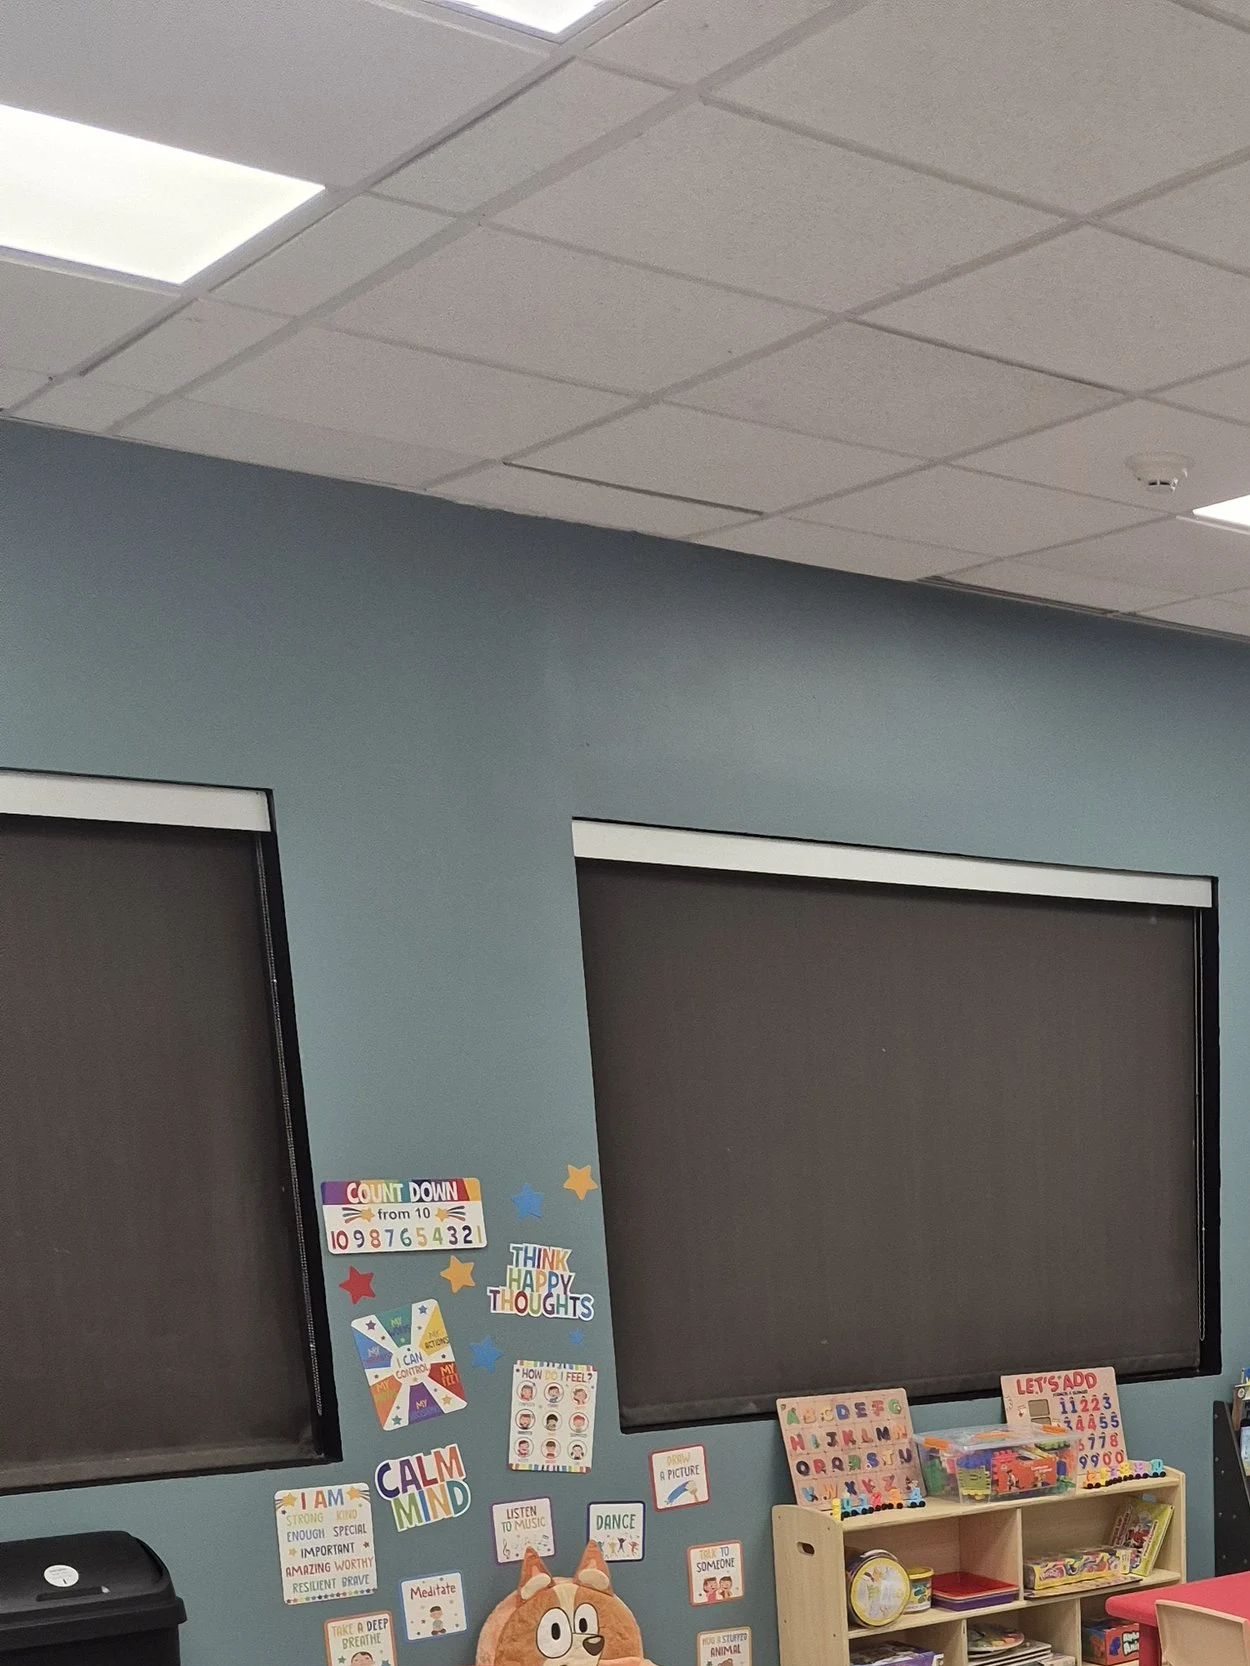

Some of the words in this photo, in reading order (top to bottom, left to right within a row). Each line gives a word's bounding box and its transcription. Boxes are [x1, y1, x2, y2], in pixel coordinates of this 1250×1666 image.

[346, 1181, 404, 1204] COUNT
[408, 1181, 458, 1203] DOWN
[377, 1208, 410, 1220] from
[415, 1207, 430, 1219] 10
[330, 1230, 349, 1250] 10
[353, 1229, 365, 1248] 9
[369, 1228, 381, 1248] 8
[385, 1228, 395, 1247] 7
[400, 1227, 412, 1247] 6
[416, 1227, 428, 1246] 5
[432, 1226, 443, 1245] 4
[447, 1226, 458, 1245] 3
[461, 1225, 473, 1244] 2
[476, 1225, 482, 1244] 1
[511, 1245, 570, 1271] THINK
[508, 1267, 572, 1295] HAPPY
[489, 1289, 593, 1319] THOUGHTS
[396, 1356, 401, 1368] I
[402, 1351, 423, 1366] CAN
[395, 1363, 429, 1379] CONTROL
[440, 1364, 455, 1374] MY
[521, 1368, 542, 1380] HOW
[544, 1370, 558, 1381] DO
[566, 1371, 593, 1383] FEEL?
[1016, 1375, 1060, 1396] LET'S
[1063, 1371, 1098, 1391] ADD
[1060, 1399, 1068, 1414] 1
[1070, 1399, 1078, 1414] 1
[1080, 1398, 1089, 1413] 2
[1091, 1397, 1100, 1412] 2
[1102, 1395, 1111, 1410] 3
[1075, 1417, 1085, 1432] 4
[1087, 1416, 1097, 1431] 4
[1099, 1414, 1108, 1429] 5
[1110, 1413, 1120, 1428] 5
[1088, 1436, 1096, 1450] 7
[1099, 1435, 1106, 1449] 7
[1110, 1434, 1118, 1448] 8
[666, 1452, 691, 1466] DRAW
[1079, 1455, 1088, 1469] 9
[1090, 1454, 1099, 1468] 9
[1102, 1452, 1111, 1466] 0
[1115, 1451, 1124, 1464] 0
[377, 1445, 465, 1498] CALM
[660, 1470, 665, 1481] A
[667, 1464, 700, 1480] PICTURE
[301, 1491, 307, 1510] I
[314, 1488, 345, 1509] AM
[392, 1480, 469, 1530] MIND
[286, 1512, 324, 1527] STRONG
[336, 1509, 358, 1521] KIND
[506, 1505, 537, 1520] LISTEN
[596, 1513, 637, 1530] DANCE
[287, 1528, 325, 1542] ENOUGH
[333, 1523, 367, 1537] SPECIAL
[501, 1521, 512, 1533] TO
[514, 1516, 546, 1531] MUSIC
[300, 1542, 355, 1558] IMPORTANT
[699, 1549, 717, 1560] TALK
[720, 1546, 730, 1557] TO
[285, 1562, 331, 1578] AMAZING
[334, 1556, 374, 1571] WORTHY
[696, 1557, 735, 1573] SOMEONE
[292, 1578, 337, 1594] RESILIENT
[342, 1574, 370, 1587] BRAVE
[410, 1582, 456, 1600] Meditate
[331, 1624, 354, 1638] TAKE
[357, 1622, 364, 1632] A
[366, 1618, 389, 1632] DEEP
[341, 1633, 381, 1649] BREATHE
[722, 1632, 748, 1644] STUFFED
[710, 1644, 741, 1657] ANIMAL
